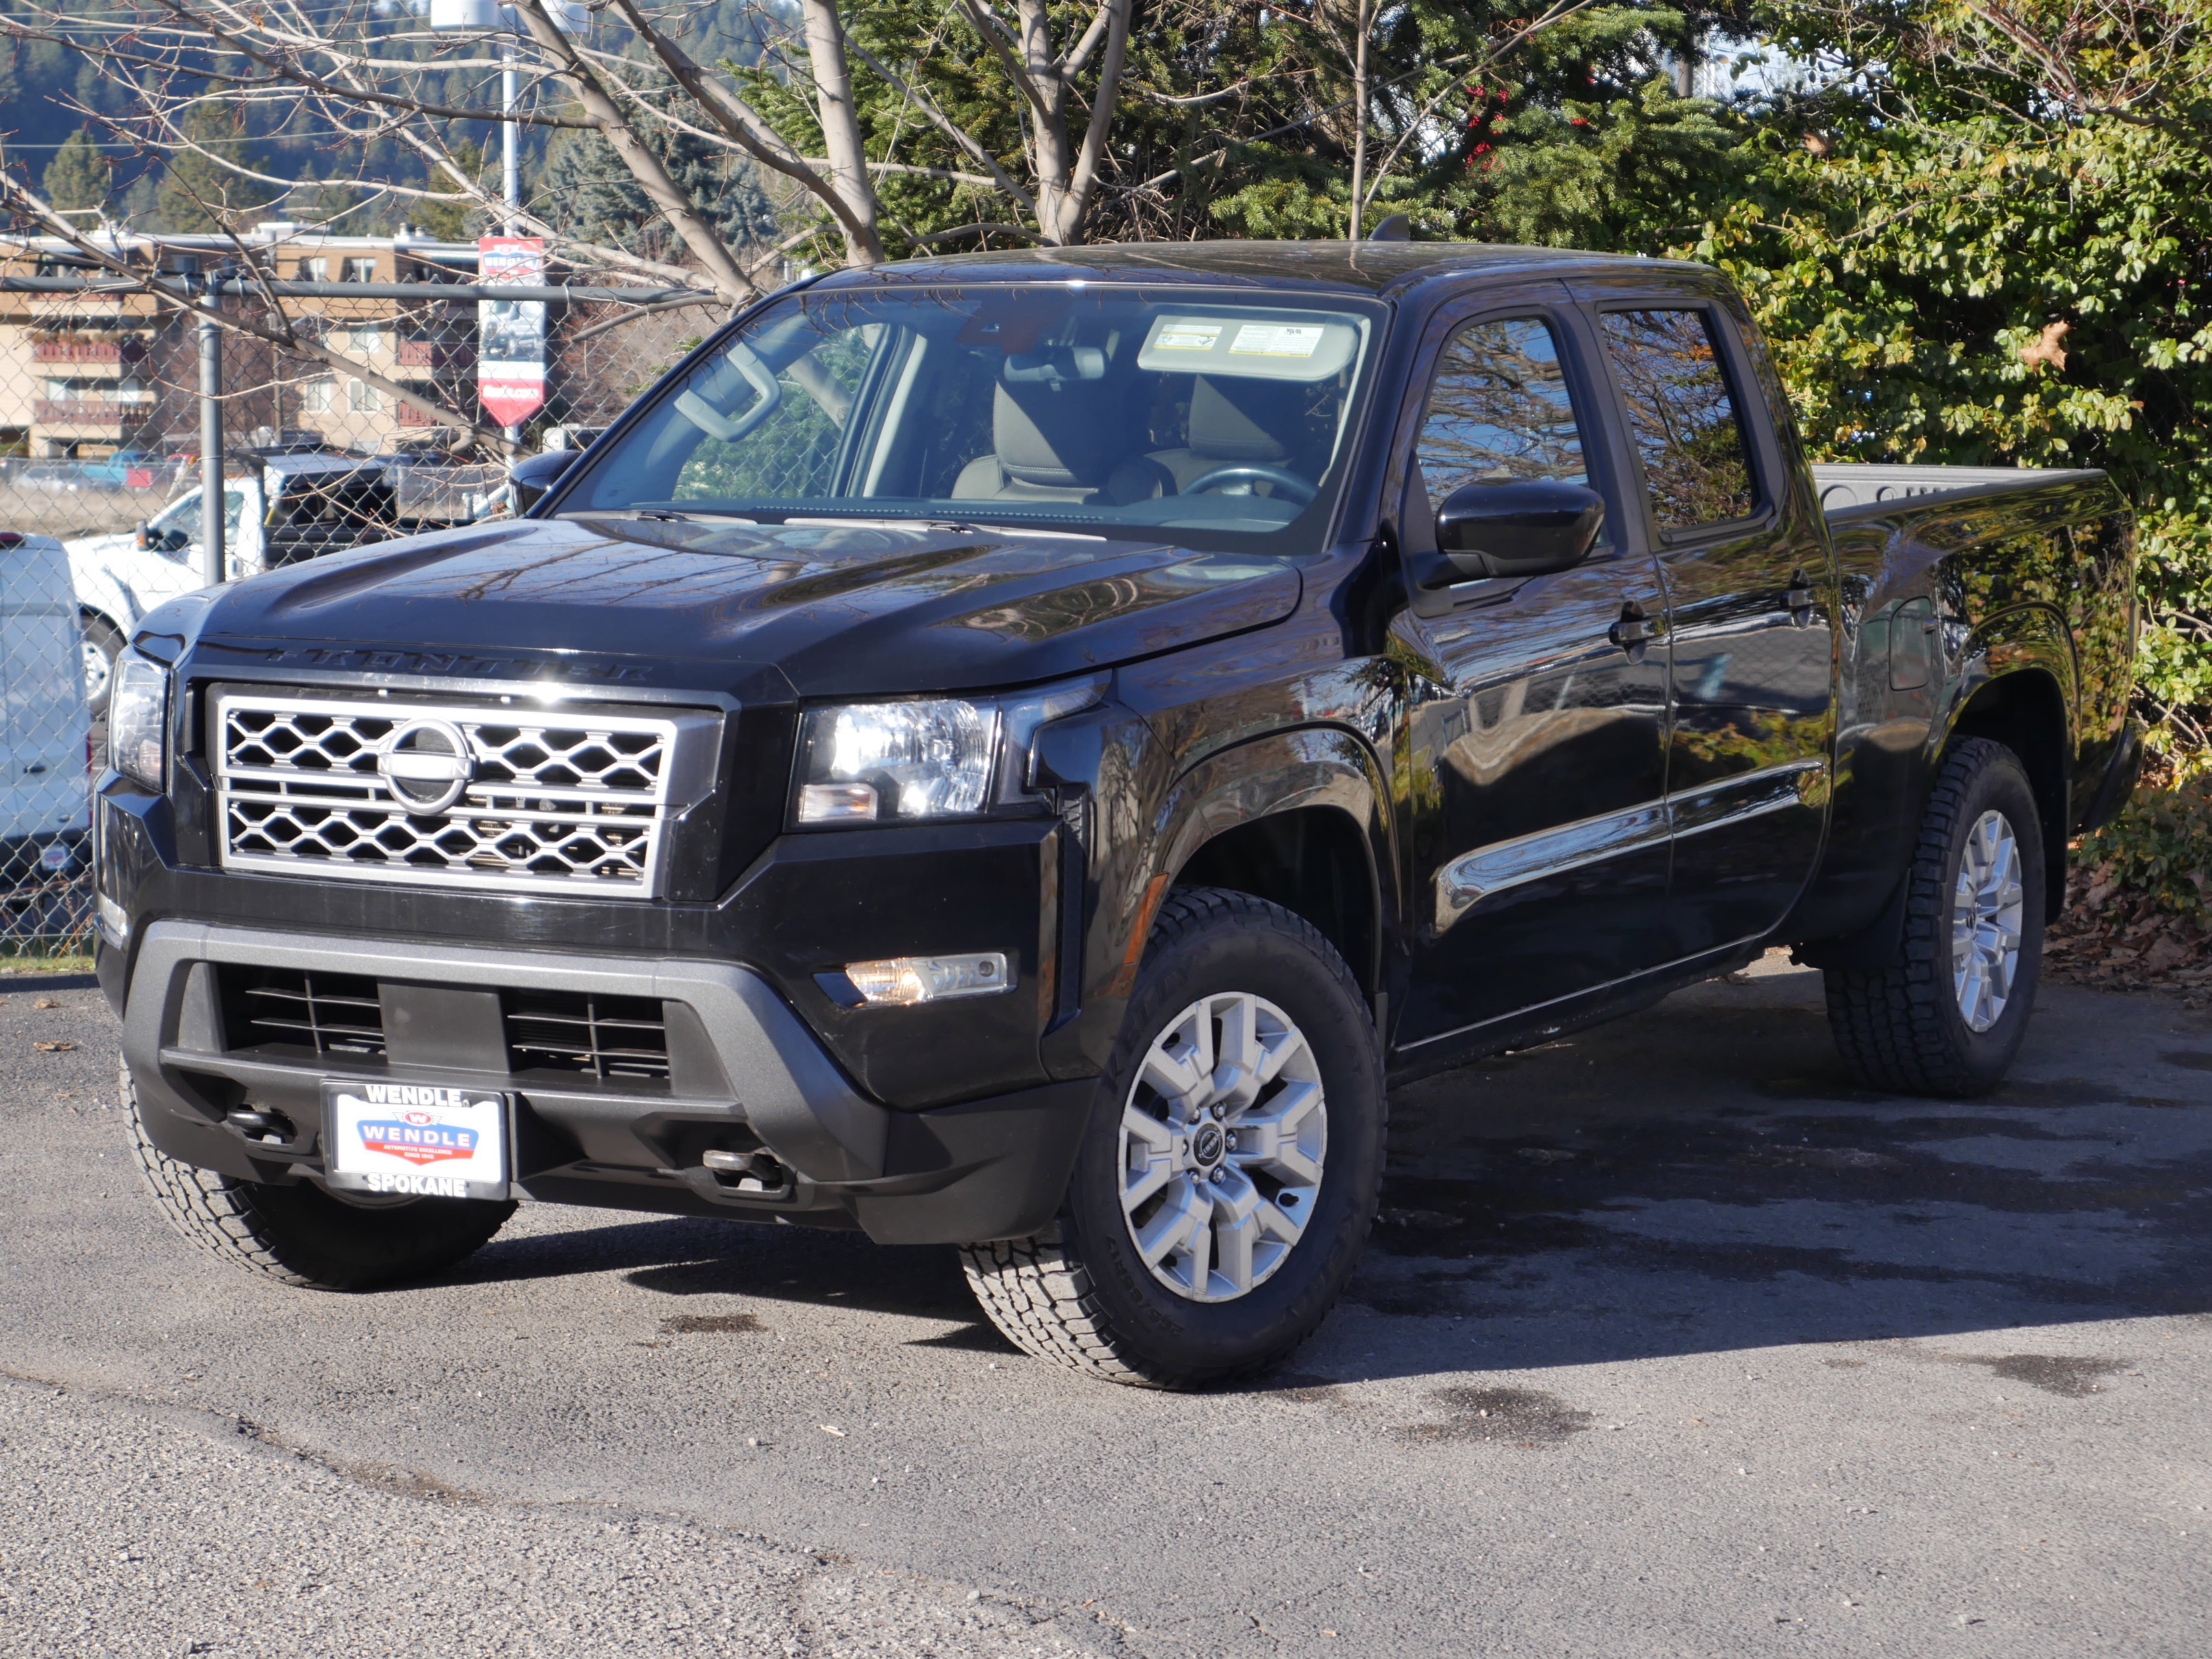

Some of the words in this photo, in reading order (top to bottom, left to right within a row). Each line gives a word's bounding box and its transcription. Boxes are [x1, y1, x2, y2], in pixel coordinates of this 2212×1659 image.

[266, 648, 654, 681] FRONTIER
[365, 1085, 462, 1107] WENDLE
[363, 1125, 470, 1147] WENDLE
[1198, 1132, 1220, 1159] NISSAN
[368, 1174, 467, 1197] SPOKANE
